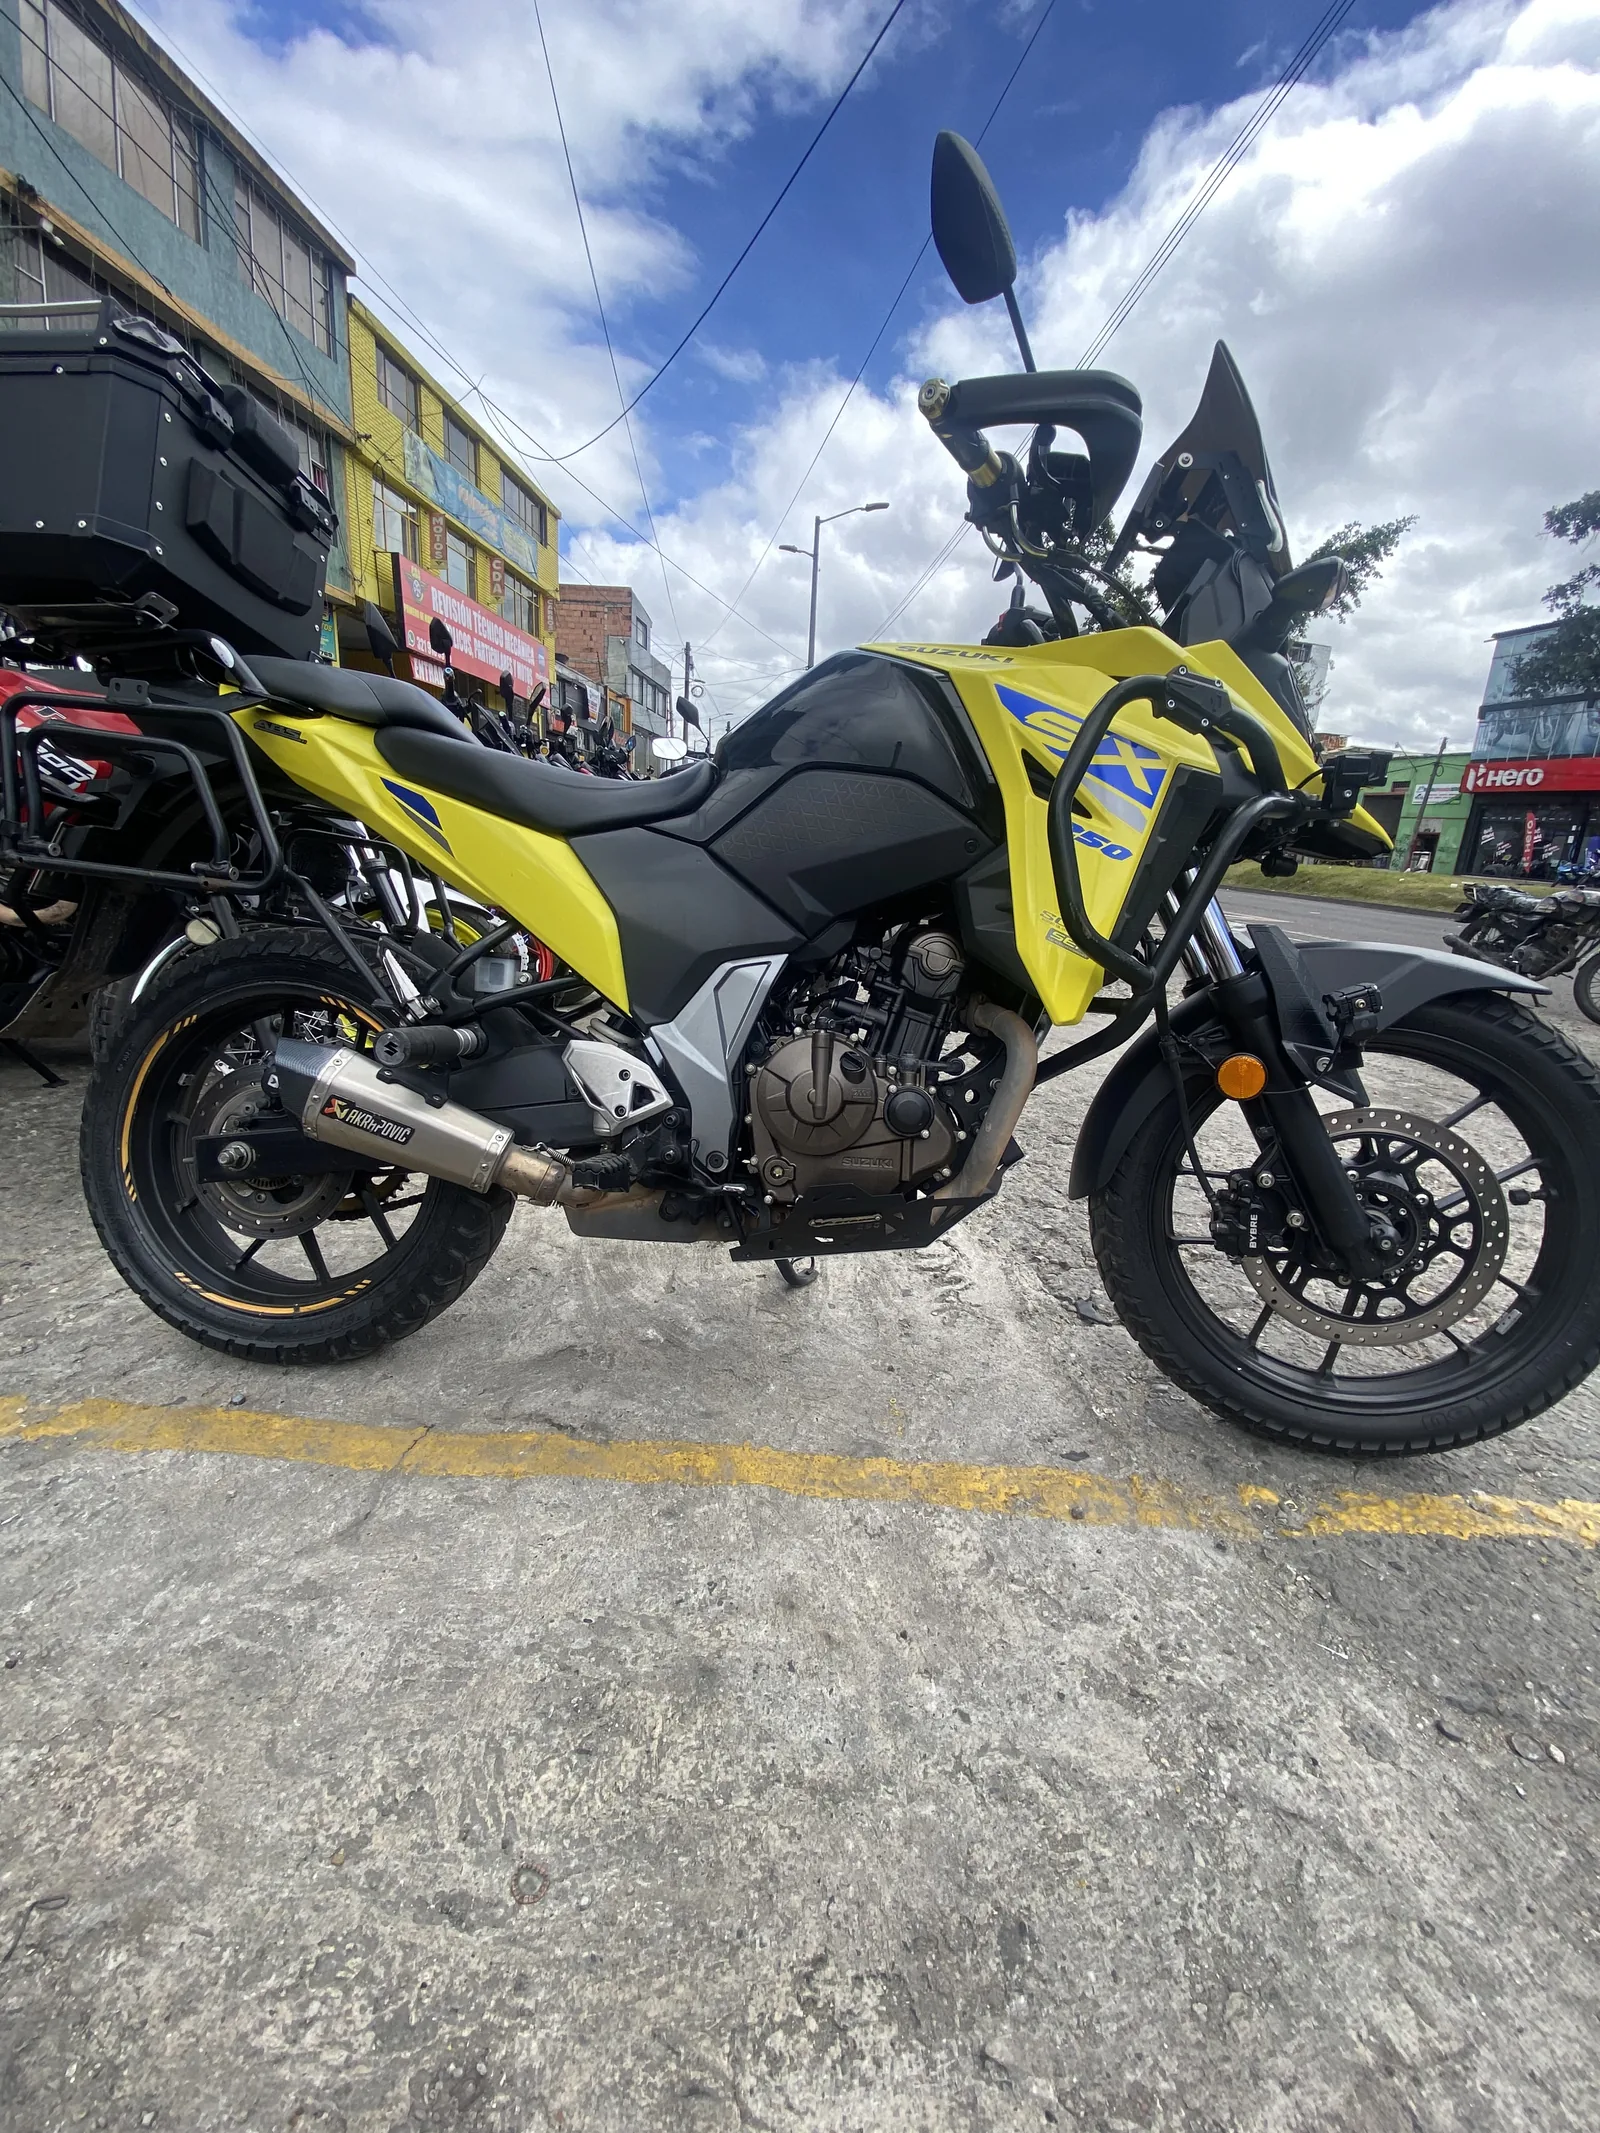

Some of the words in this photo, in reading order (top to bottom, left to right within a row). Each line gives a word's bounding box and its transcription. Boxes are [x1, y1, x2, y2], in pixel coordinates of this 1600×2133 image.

[432, 517, 444, 559] MOTOS
[492, 560, 503, 594] CDA
[430, 586, 473, 631] REVISIÓN
[472, 609, 504, 648] TÉCNICO
[895, 644, 1014, 664] SUZUKI
[842, 1156, 894, 1169] SUZUKI
[1249, 1213, 1258, 1249] BYBRE
